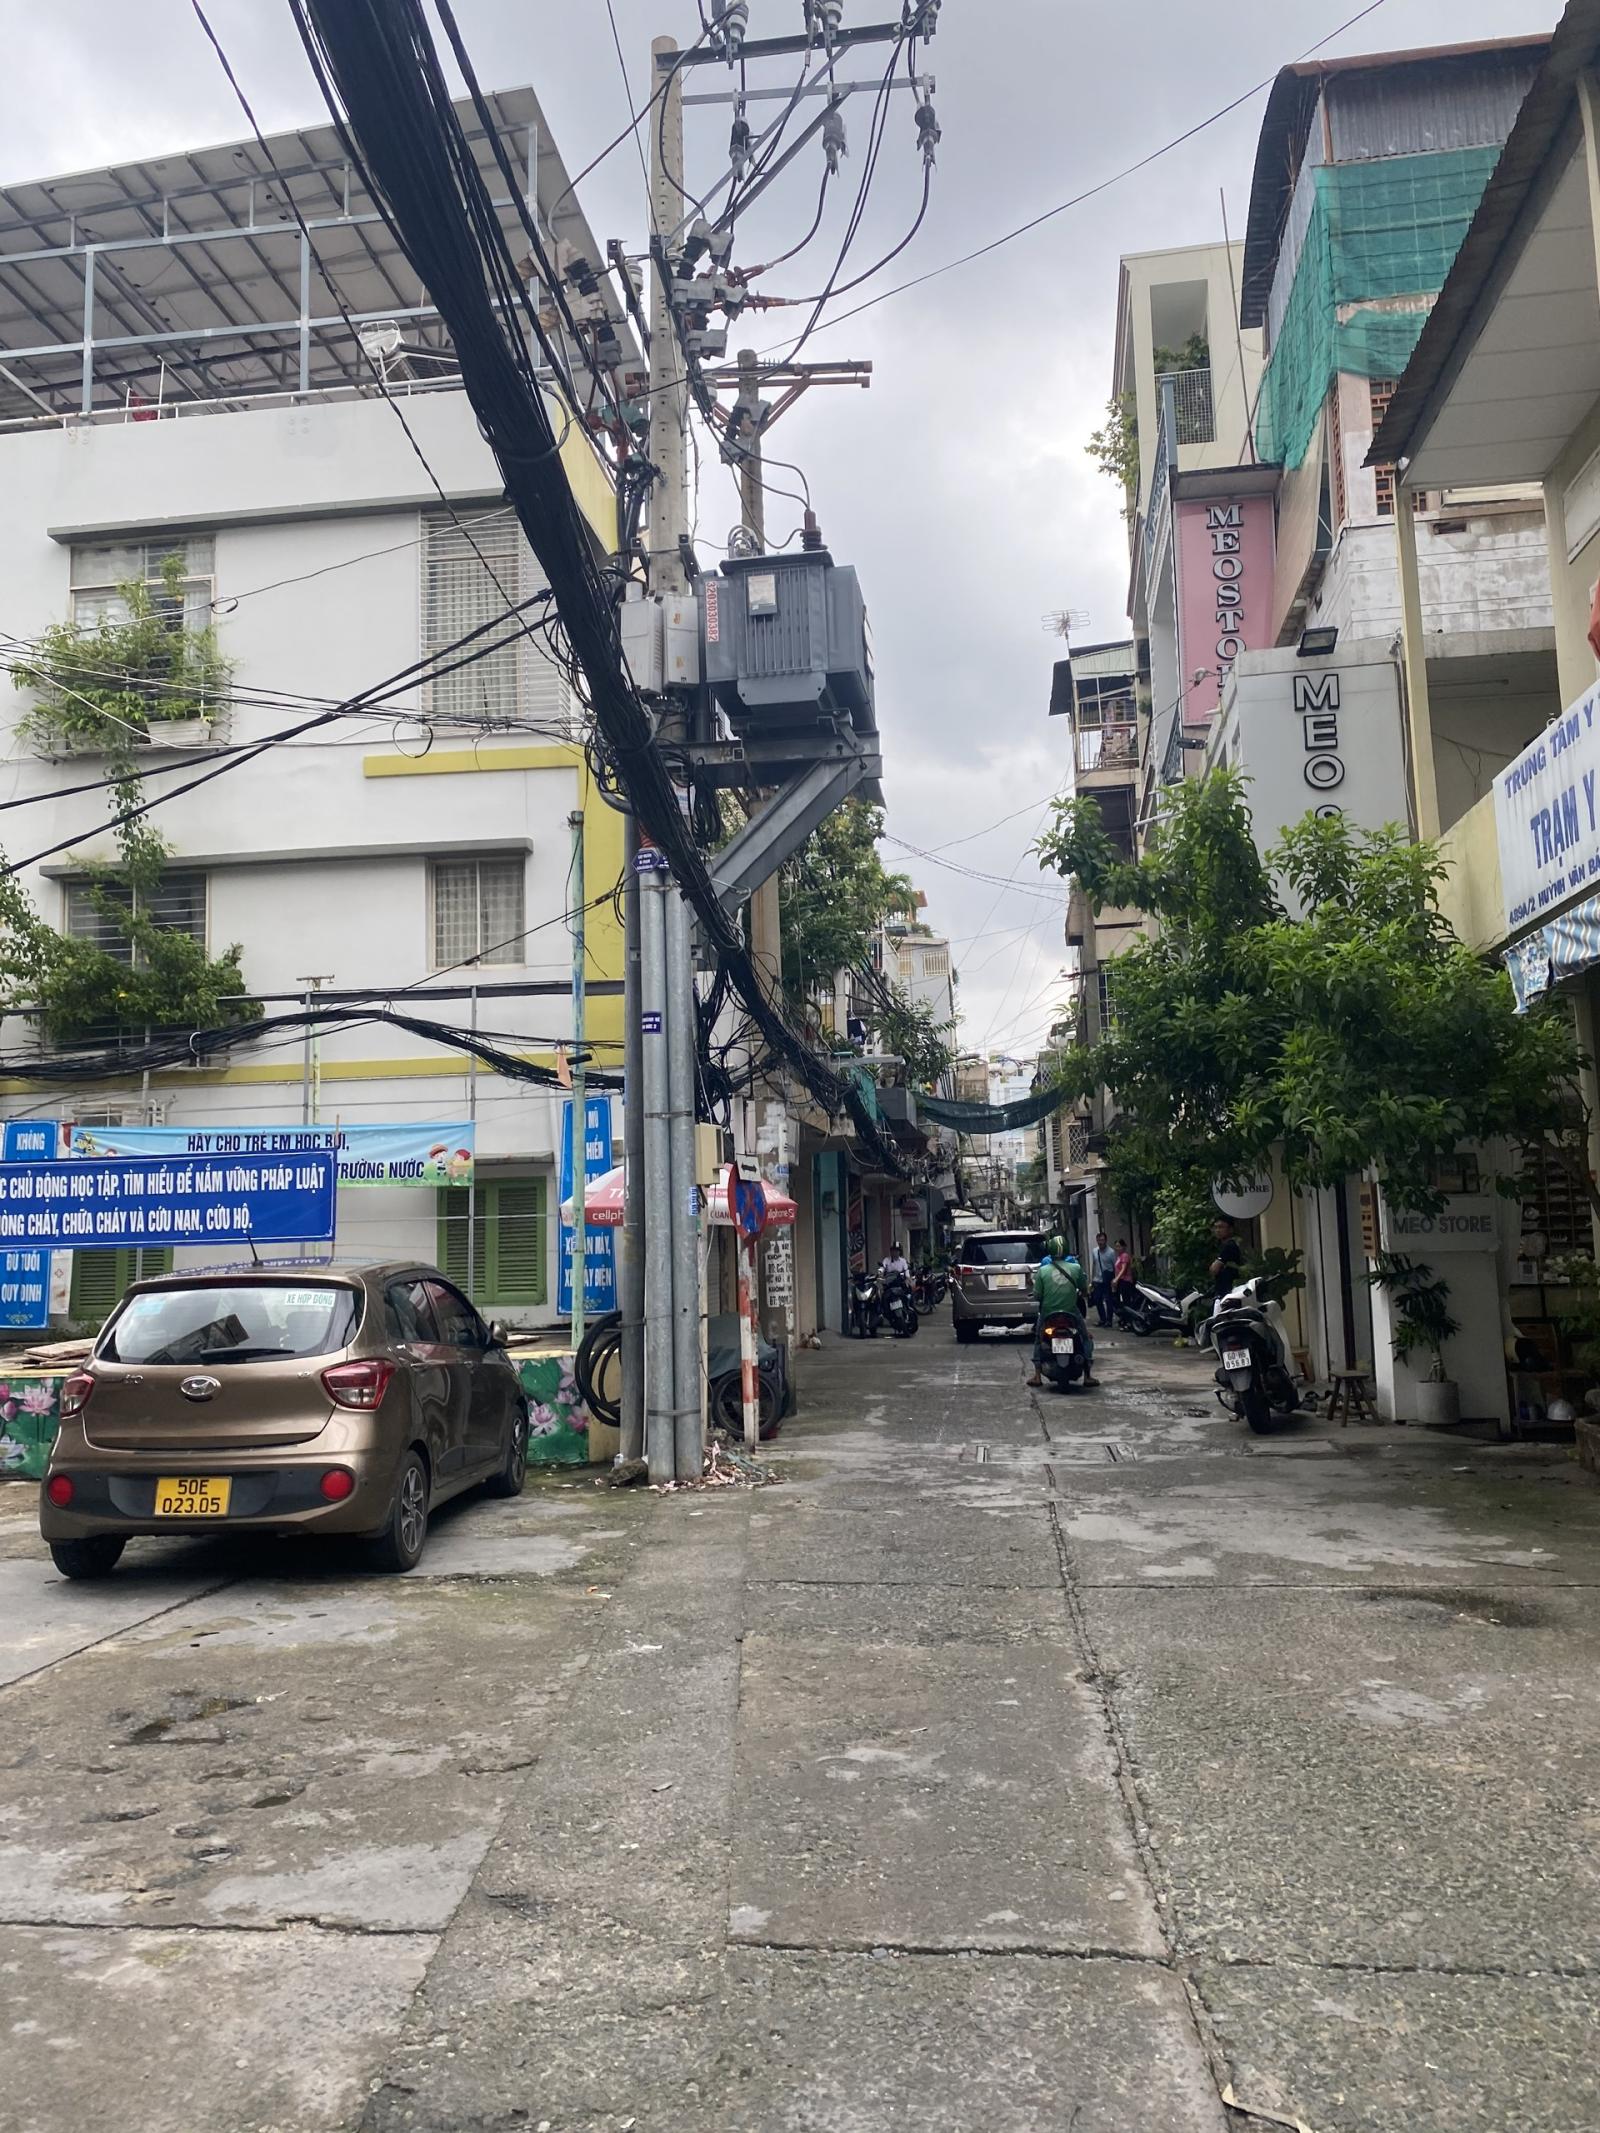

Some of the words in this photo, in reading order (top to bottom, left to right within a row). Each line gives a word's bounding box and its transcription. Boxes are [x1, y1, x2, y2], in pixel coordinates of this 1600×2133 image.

[1206, 503, 1247, 698] MEOSTO
[1293, 673, 1345, 791] MEO
[1504, 746, 1547, 799] TRUNG
[1550, 720, 1580, 758] TÂM
[1583, 698, 1595, 729] Y
[1529, 784, 1580, 869] TRẠM
[1583, 767, 1596, 832] Y
[216, 1134, 241, 1151] CHO
[271, 1134, 291, 1150] EM
[9, 1170, 33, 1199] CHỦ
[35, 1172, 68, 1202] ĐỘNG
[70, 1175, 94, 1201] HỌC
[97, 1169, 120, 1200] TẬP,
[123, 1168, 144, 1195] TÌM
[147, 1163, 174, 1195] HIỂU
[176, 1163, 193, 1194] ĐỂ
[195, 1162, 223, 1193] NẮM
[226, 1165, 258, 1192] VỮNG
[261, 1163, 293, 1191] PHÁP
[295, 1162, 326, 1194] LUẬT
[389, 1158, 425, 1179] NƯỚC
[0, 1209, 25, 1237] ÒNG
[27, 1209, 59, 1237] CHÁY,
[62, 1208, 94, 1235] CHỮA
[96, 1207, 127, 1234] CHÁY
[129, 1206, 145, 1233] VÀ
[148, 1205, 172, 1233] CỨU
[174, 1208, 204, 1236] NẠN,
[206, 1202, 230, 1231] CỨU
[233, 1202, 253, 1234] HỘ.
[1392, 1215, 1434, 1234] MEO
[1439, 1215, 1492, 1234] STORE
[1, 1283, 20, 1304] QUY
[177, 1479, 210, 1495] 50E
[162, 1497, 221, 1513] 023.05
